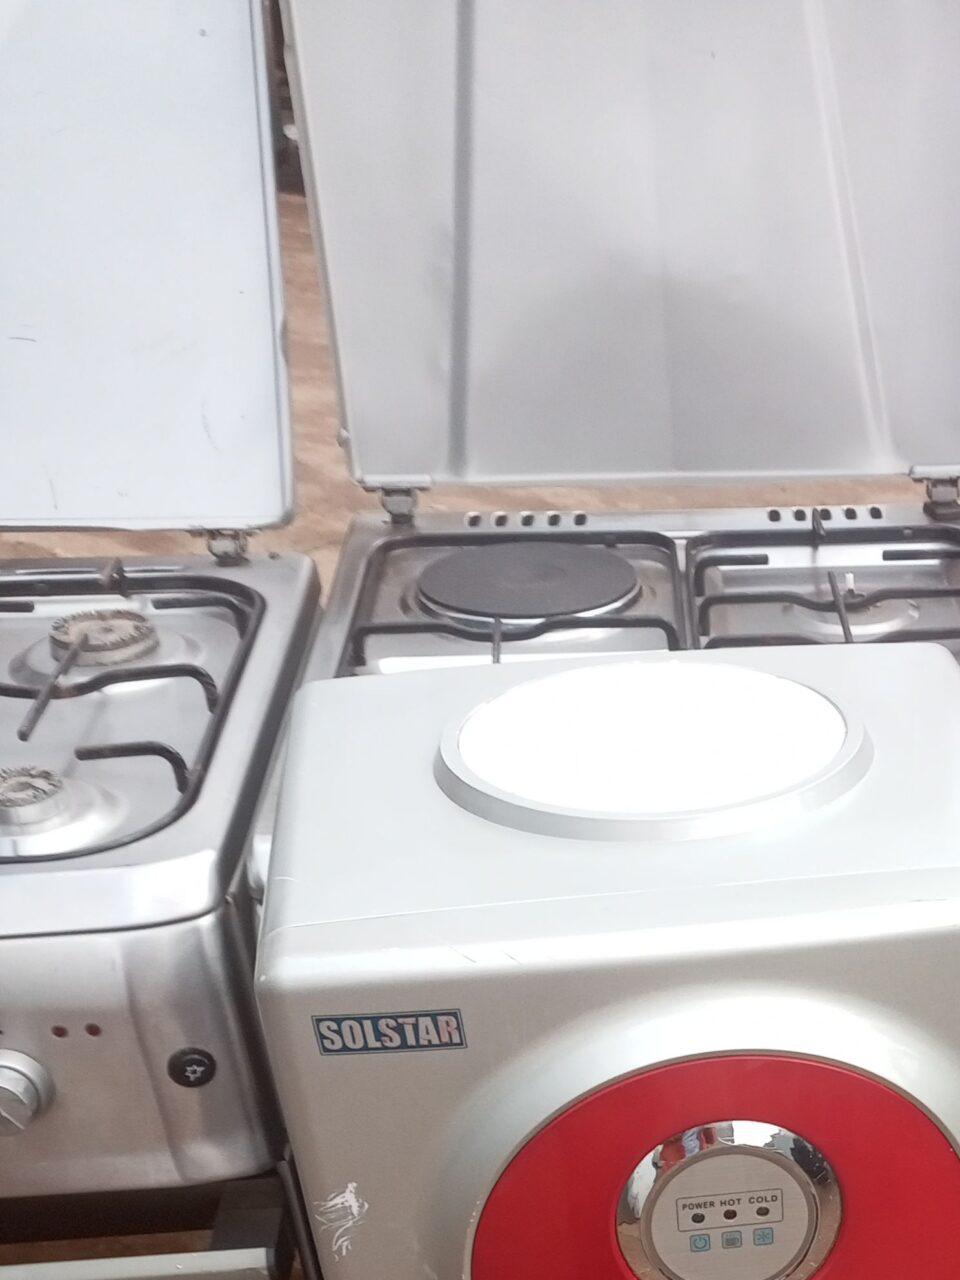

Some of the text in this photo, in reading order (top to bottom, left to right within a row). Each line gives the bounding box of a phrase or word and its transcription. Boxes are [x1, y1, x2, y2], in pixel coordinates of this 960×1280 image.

[318, 1015, 461, 1050] SOLSTAR
[681, 1195, 779, 1211] POWER HOT COLD
